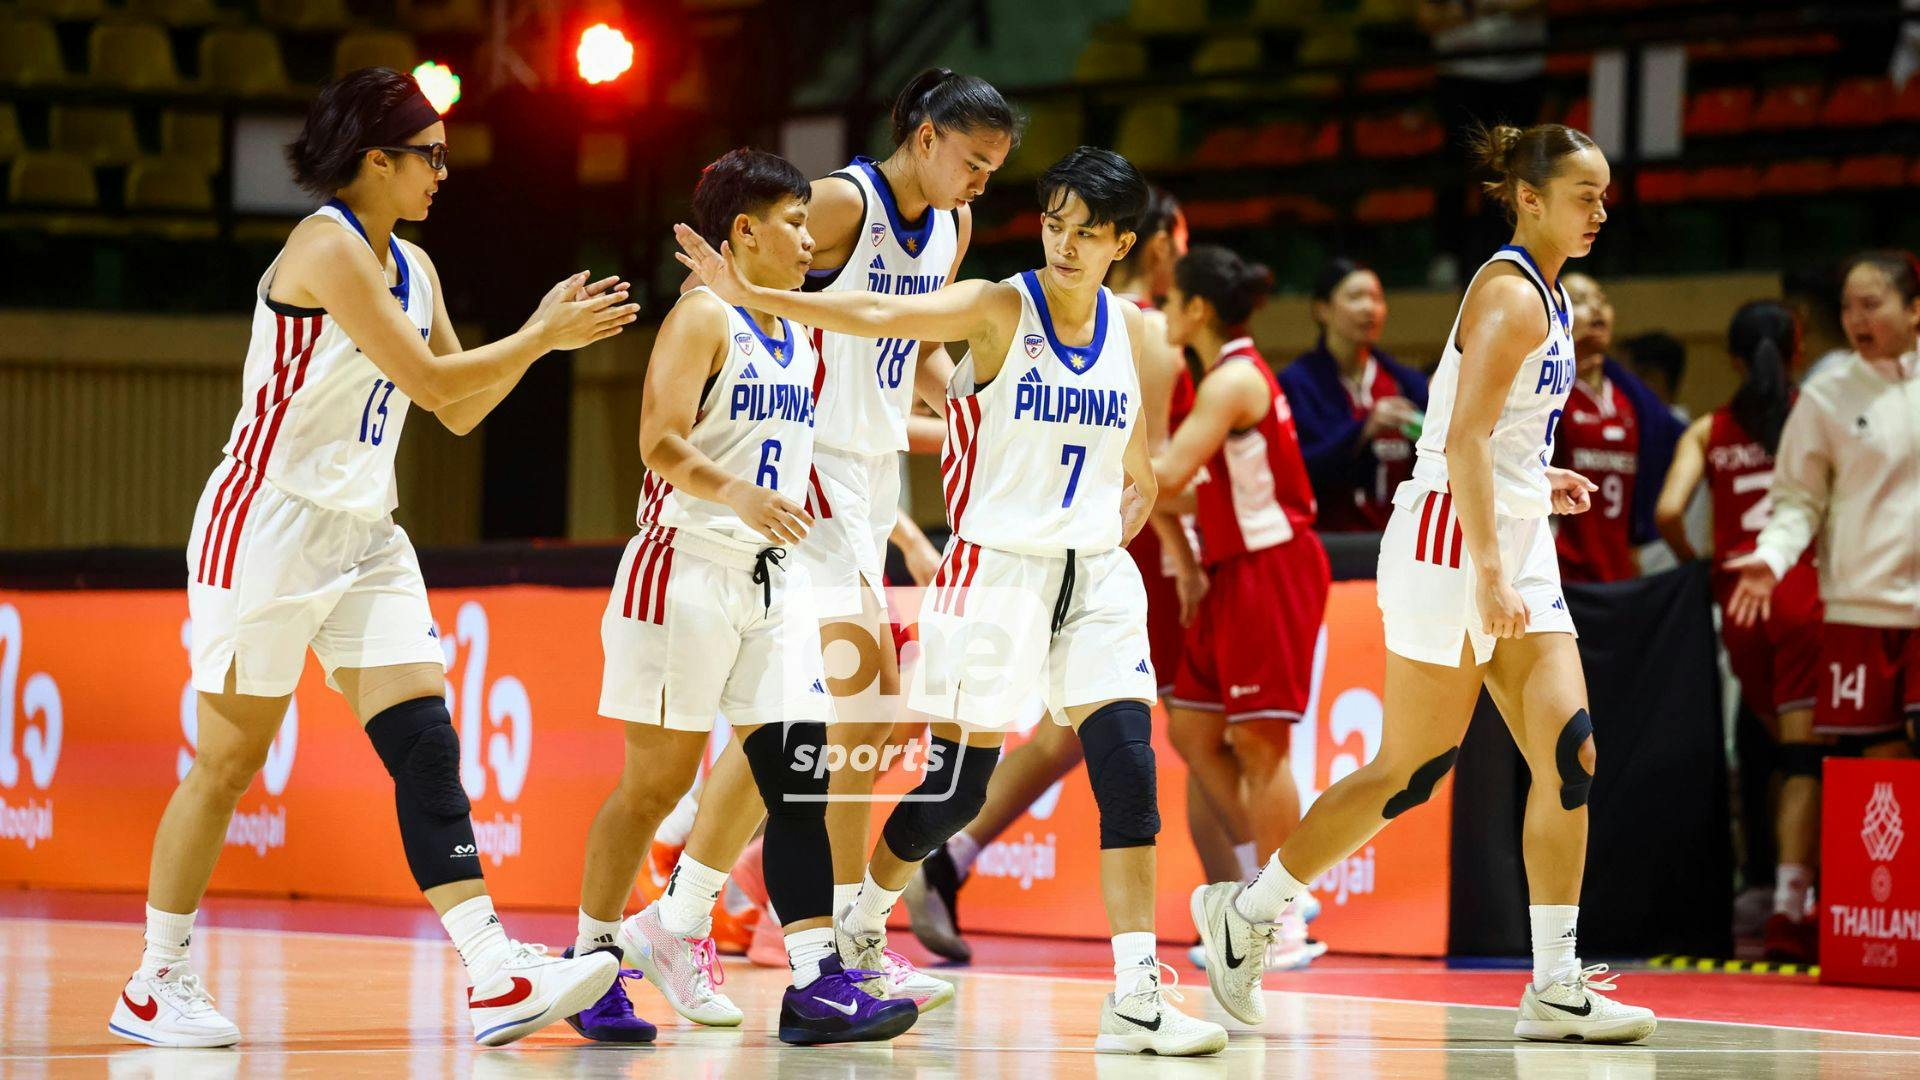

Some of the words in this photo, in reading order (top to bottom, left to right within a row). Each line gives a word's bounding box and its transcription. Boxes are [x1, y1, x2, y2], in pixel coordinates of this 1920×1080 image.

[359, 379, 395, 446] 13
[730, 384, 815, 428] PILIPINAS
[1014, 383, 1128, 430] PILIPINAS
[756, 438, 782, 491] 6
[1060, 443, 1087, 509] 7
[1602, 474, 1623, 519] 9
[1829, 662, 1867, 710] 14
[470, 812, 522, 866] oojai
[1308, 846, 1375, 905] ojai
